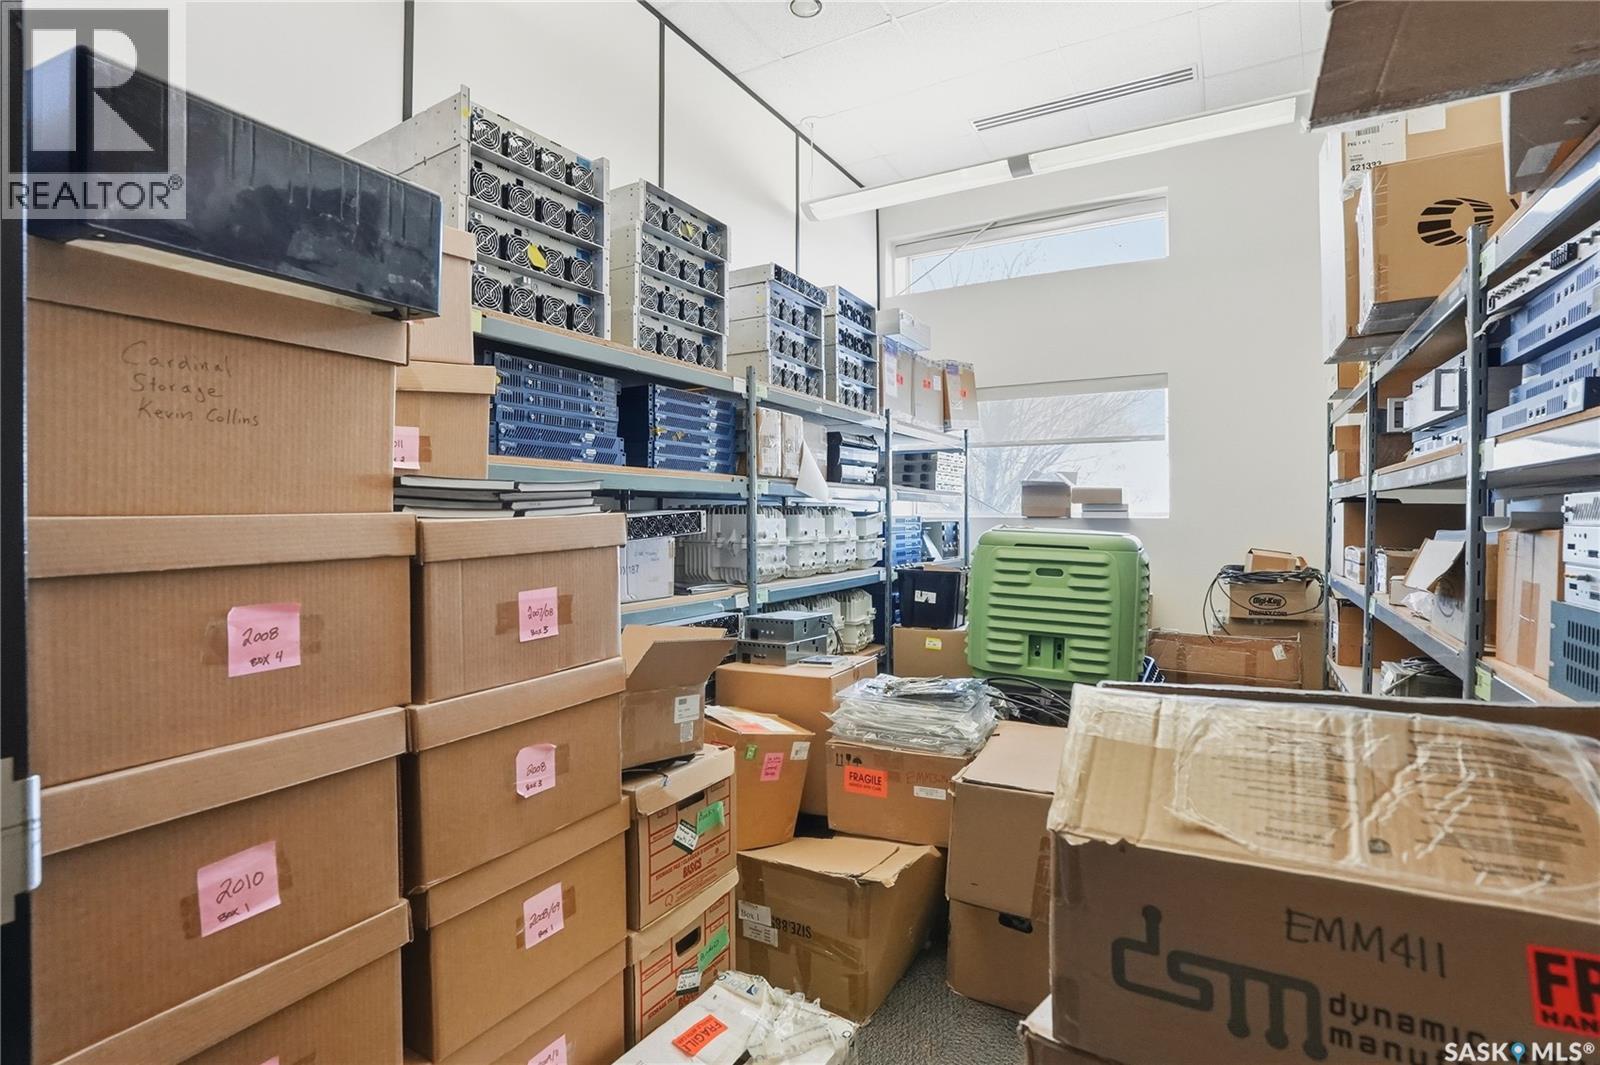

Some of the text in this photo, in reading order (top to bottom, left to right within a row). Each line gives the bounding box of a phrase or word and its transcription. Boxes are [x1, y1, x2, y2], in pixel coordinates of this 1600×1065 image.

[121, 340, 232, 378] Cardinal
[130, 372, 224, 403] Storage
[137, 397, 260, 427] Kevin Collins
[242, 626, 280, 647] 2008
[275, 649, 284, 663] 4
[526, 761, 547, 777] 2008
[848, 771, 882, 786] FRAGILE
[215, 871, 264, 905] 2010
[244, 902, 249, 912] 1
[1285, 907, 1447, 978] EMM411
